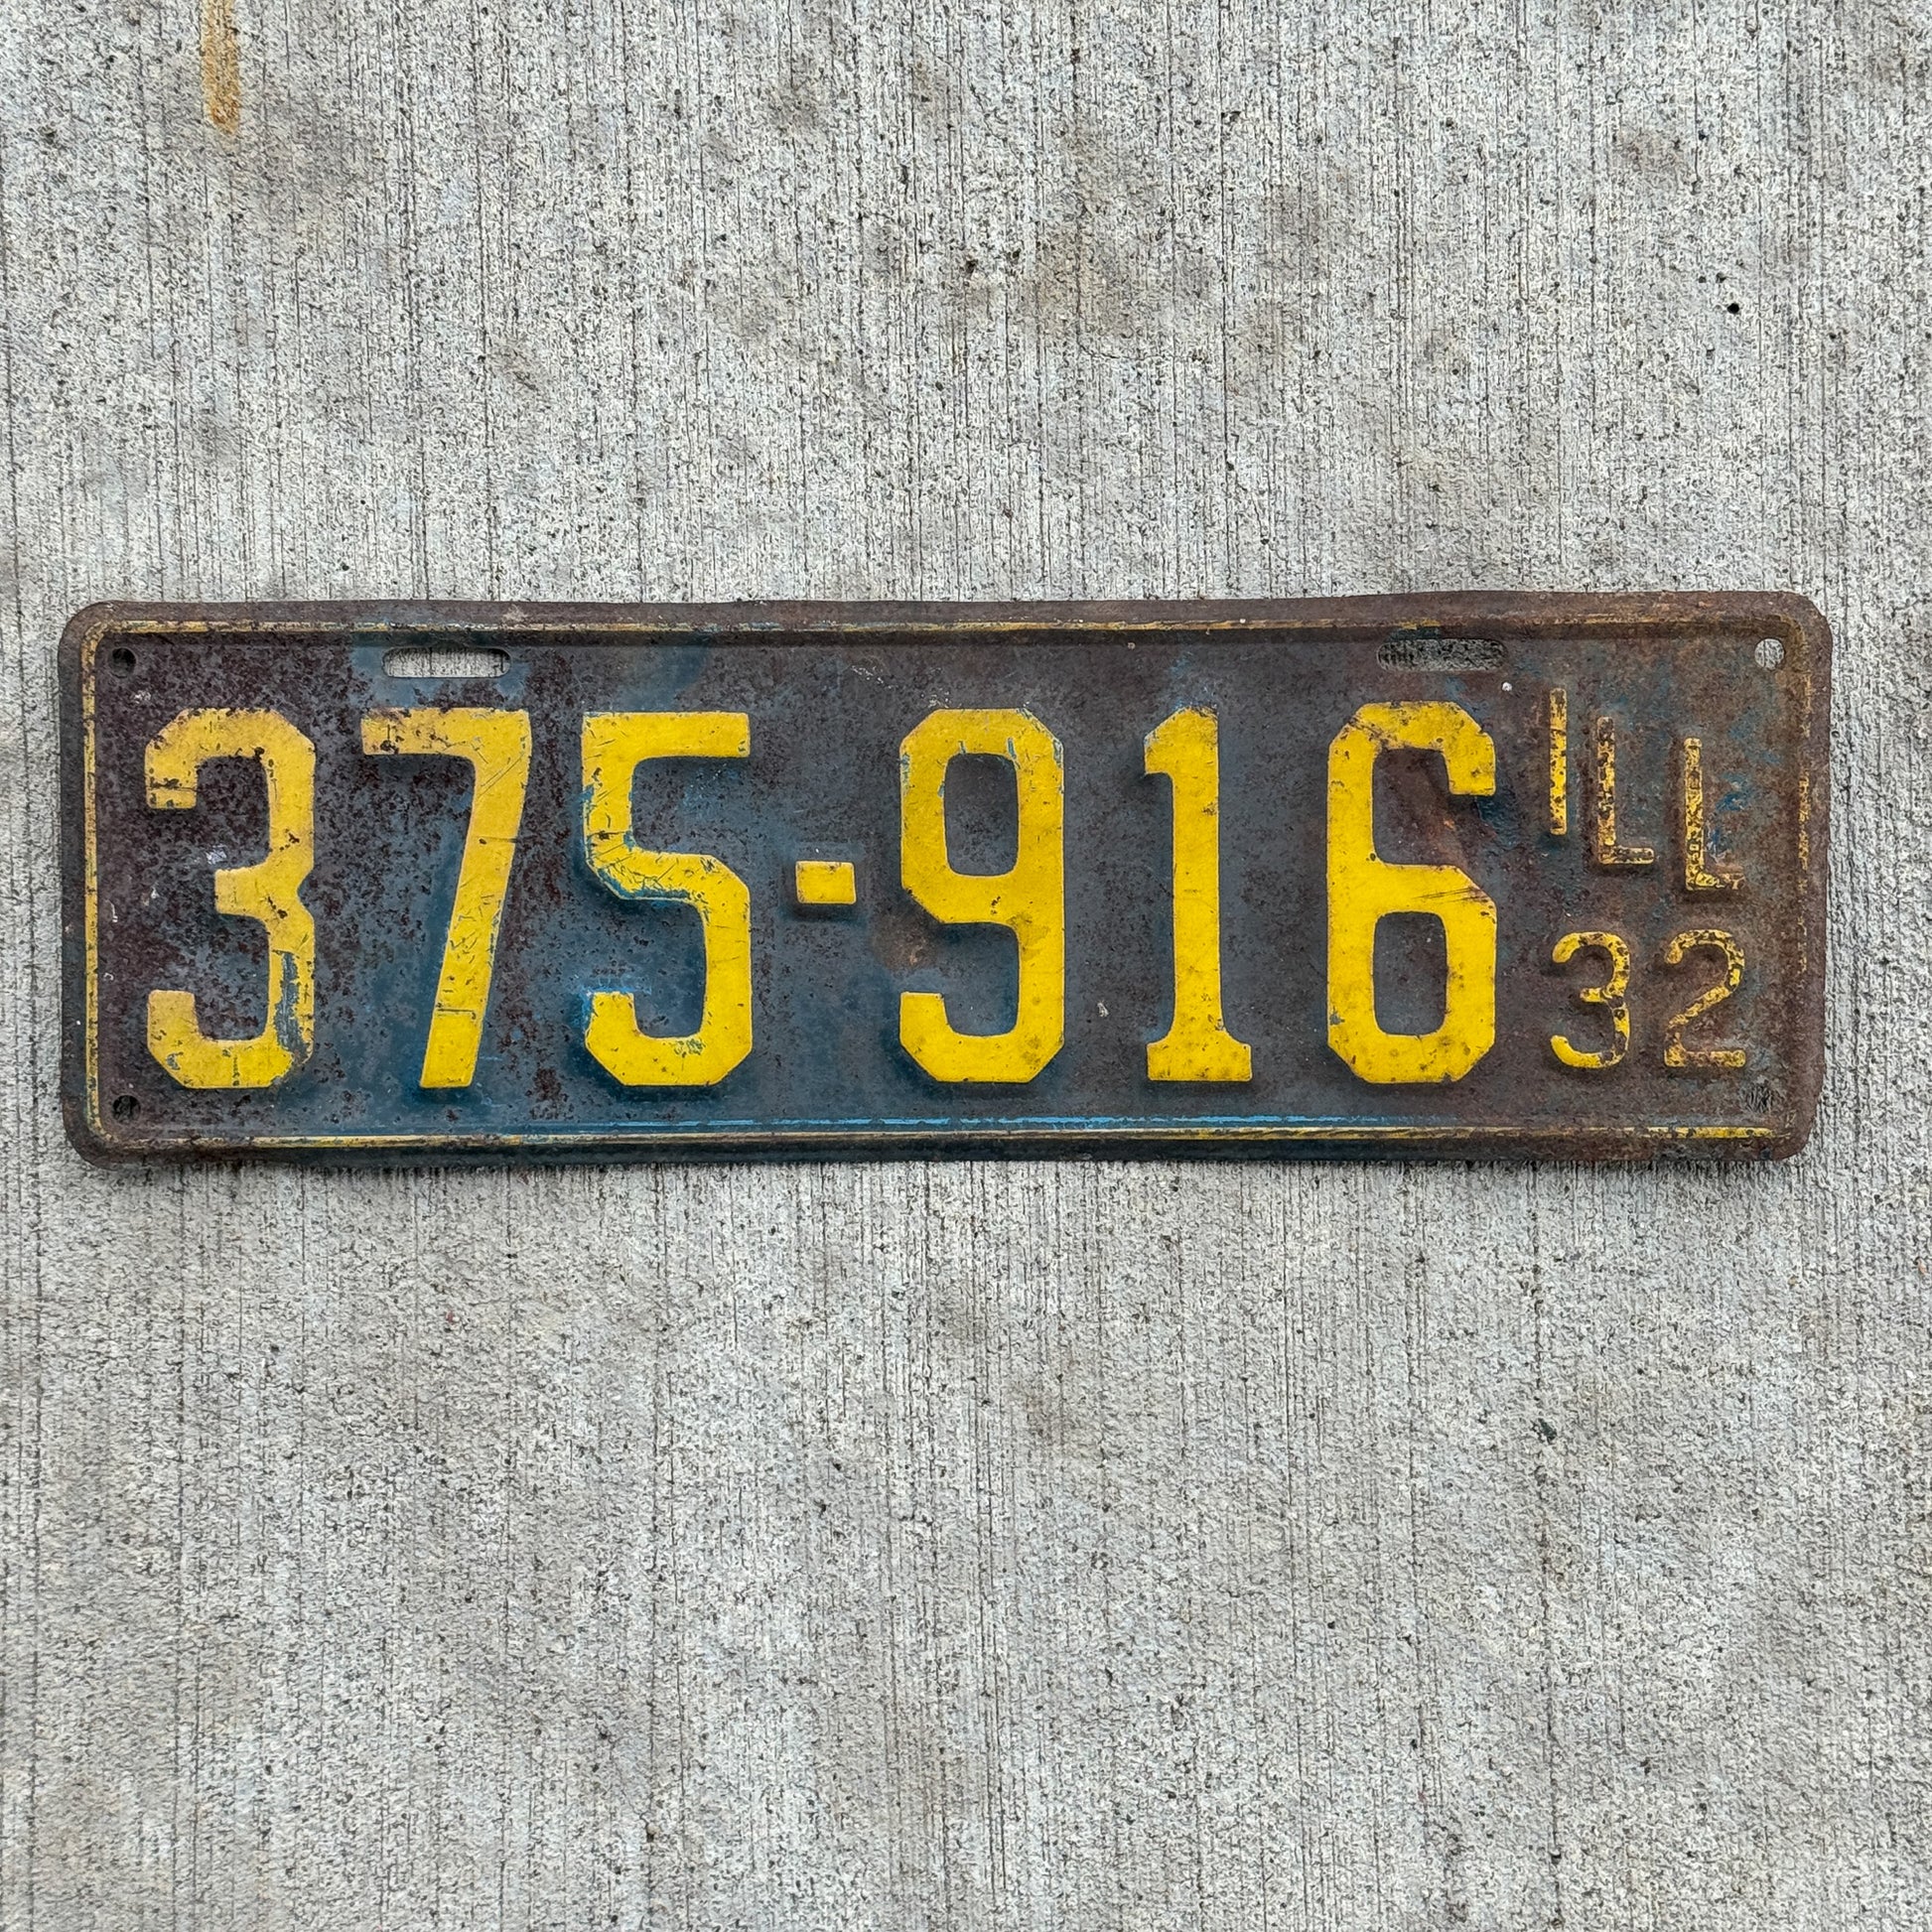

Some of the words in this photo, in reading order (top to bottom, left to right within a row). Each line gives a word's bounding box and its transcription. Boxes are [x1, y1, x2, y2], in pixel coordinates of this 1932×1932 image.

[1549, 687, 1745, 892] ILL
[145, 701, 1497, 1089] 375-916
[1550, 929, 1746, 1068] 32
